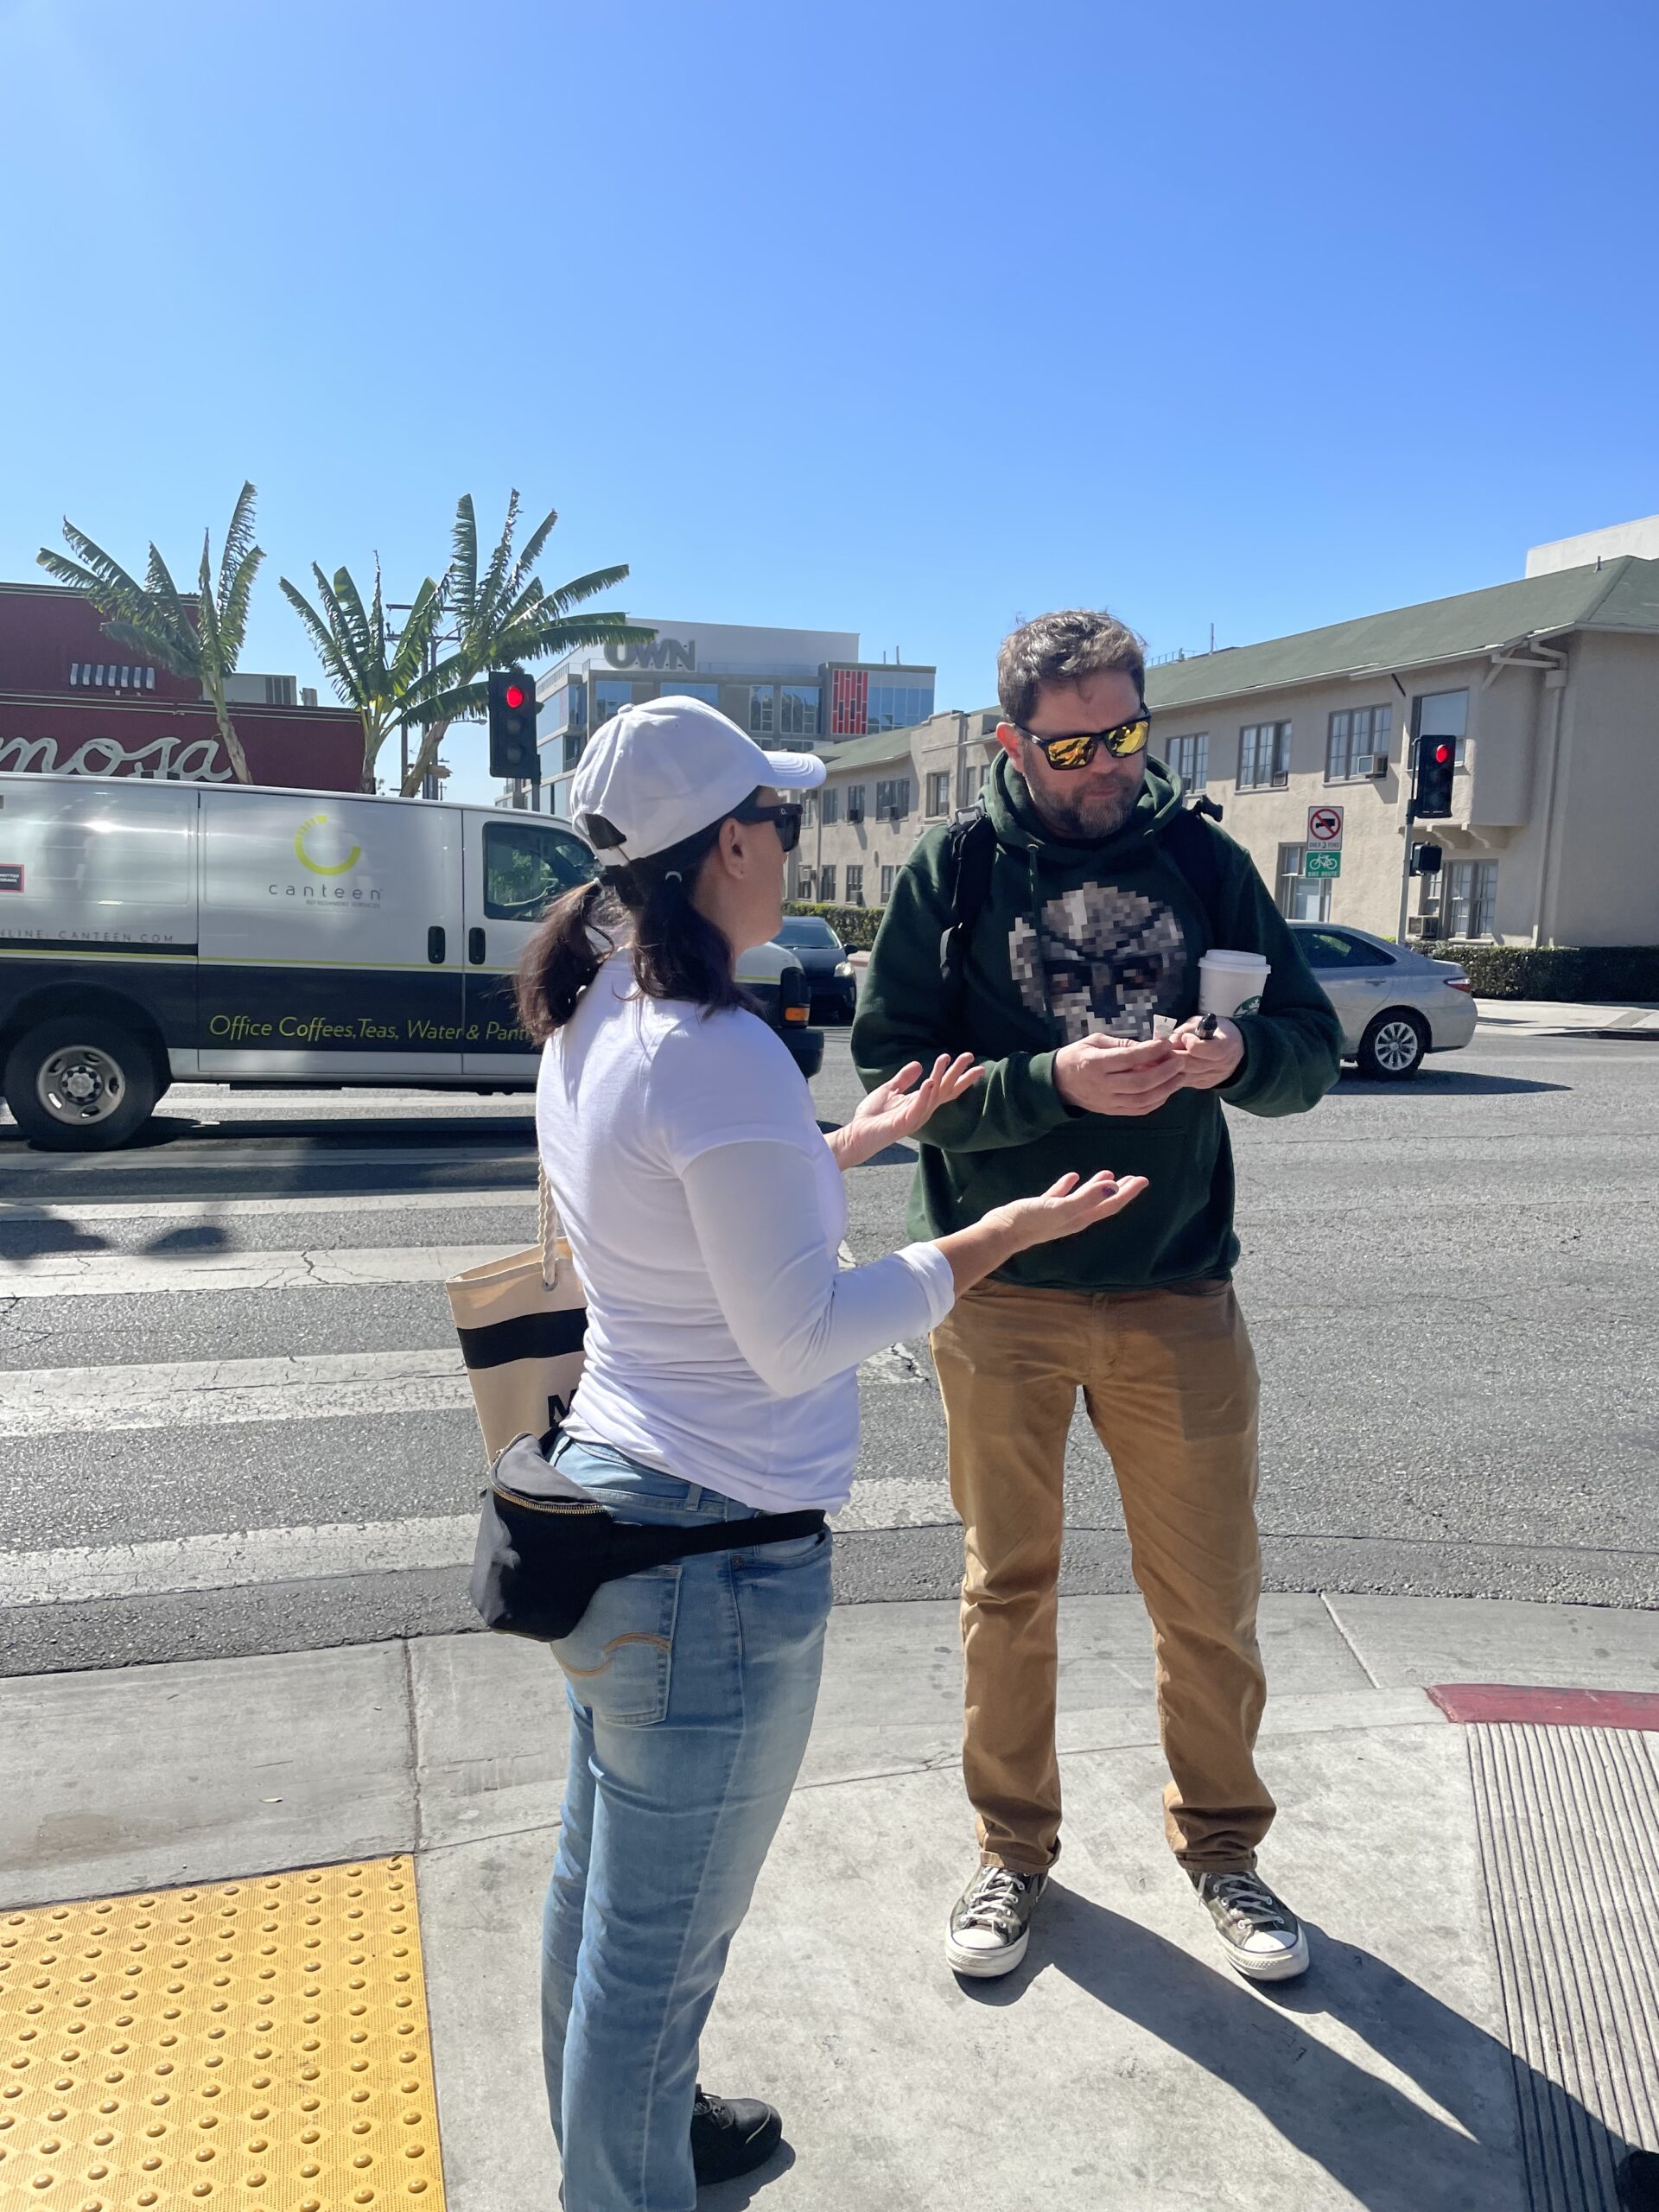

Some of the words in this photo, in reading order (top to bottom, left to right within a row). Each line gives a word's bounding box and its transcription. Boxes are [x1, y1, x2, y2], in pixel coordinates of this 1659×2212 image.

[269, 884, 380, 899] canteen
[210, 1014, 272, 1040] Office
[408, 1020, 462, 1039] Water
[466, 1025, 479, 1040] &
